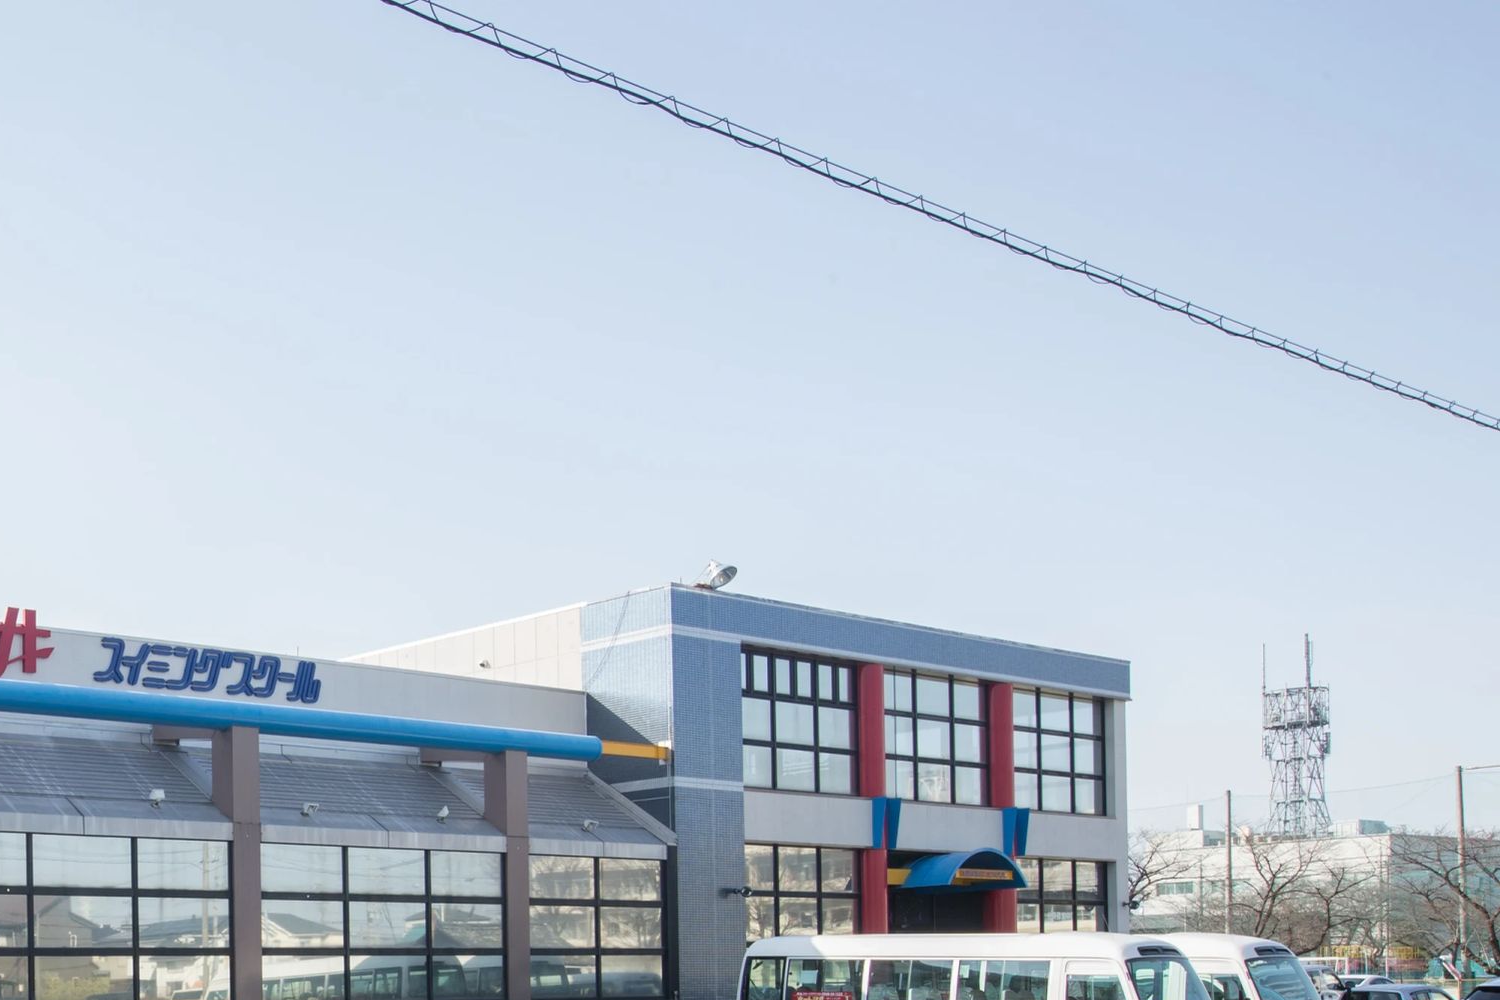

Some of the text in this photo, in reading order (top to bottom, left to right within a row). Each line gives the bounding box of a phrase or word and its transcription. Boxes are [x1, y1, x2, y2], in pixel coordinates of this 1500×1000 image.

[93, 636, 322, 704] スイミングスクール
